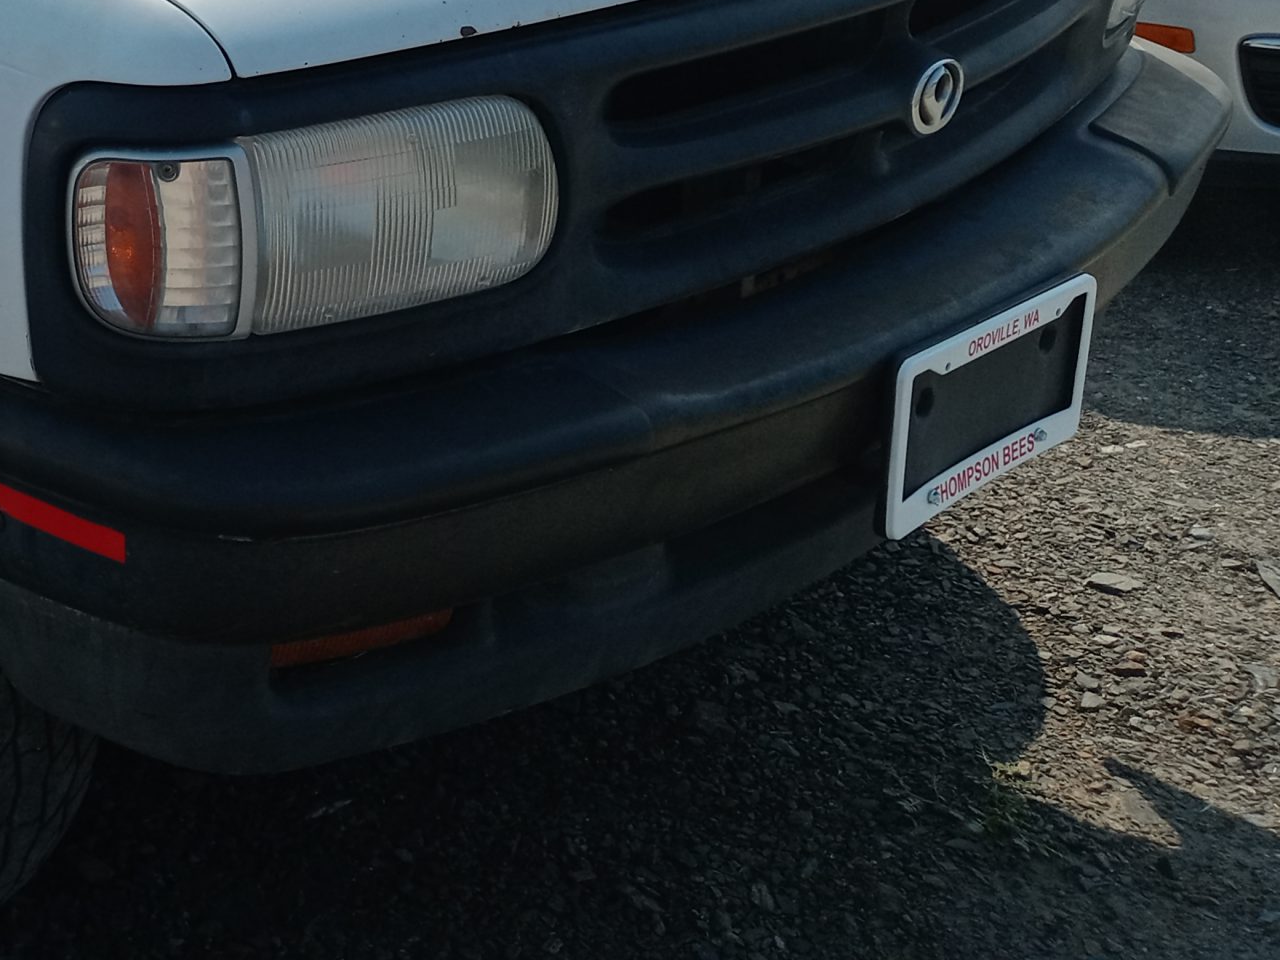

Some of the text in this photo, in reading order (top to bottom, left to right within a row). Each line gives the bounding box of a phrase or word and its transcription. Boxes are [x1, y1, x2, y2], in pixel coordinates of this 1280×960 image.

[968, 309, 1040, 357] OROVILLE, WA
[1002, 432, 1036, 468] BEES
